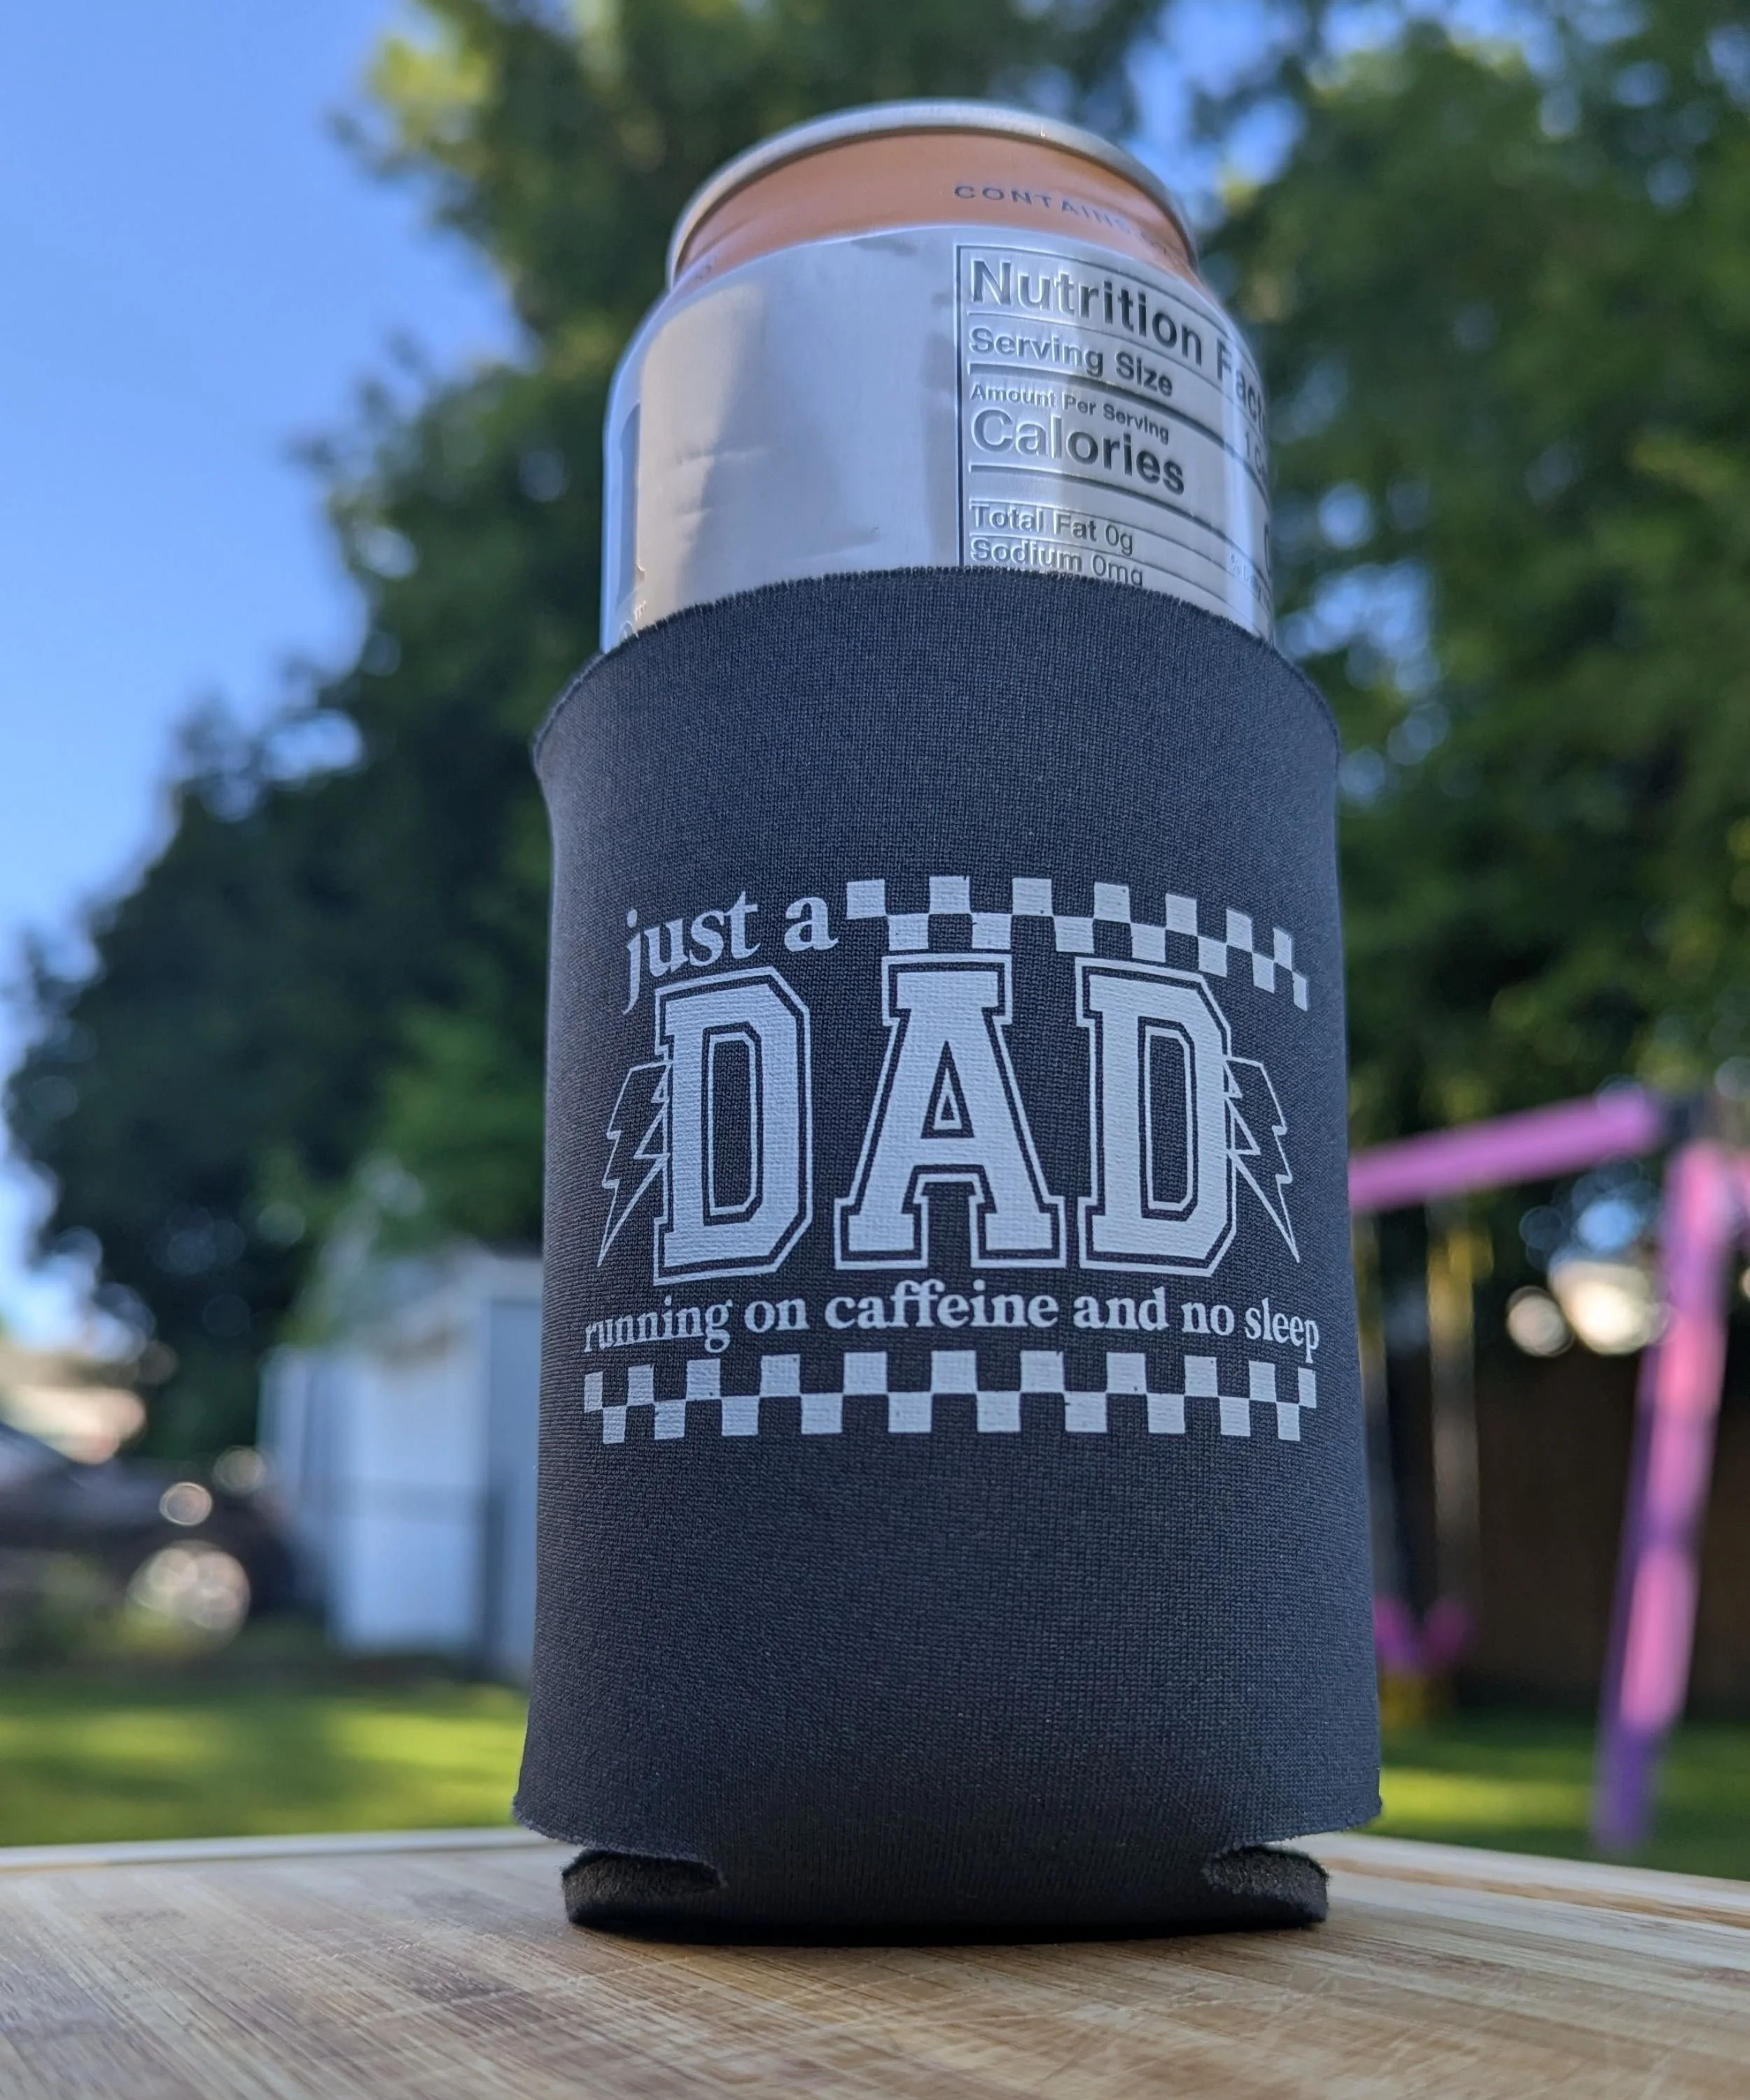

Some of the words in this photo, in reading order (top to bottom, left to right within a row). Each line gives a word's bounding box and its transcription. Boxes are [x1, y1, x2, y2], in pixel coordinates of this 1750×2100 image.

[970, 257, 1203, 366] Nutrition
[969, 326, 1104, 377] Serving
[1115, 351, 1173, 397] Size
[969, 382, 1057, 407] Amount
[1062, 391, 1097, 416] Per
[1102, 402, 1170, 446] Serving
[970, 407, 1184, 496] Calories
[970, 537, 1083, 573] Sodium
[1091, 554, 1143, 587] 0mg
[971, 503, 1044, 533] Total
[1053, 510, 1097, 542] Fat
[1105, 524, 1133, 556] 0g
[623, 890, 762, 1015] just
[783, 896, 839, 953] a
[653, 951, 1236, 1285] DAD
[584, 1294, 734, 1354] running
[743, 1296, 808, 1333] on
[824, 1278, 1060, 1330] caffeine
[1072, 1286, 1169, 1331] and
[1180, 1301, 1236, 1336] no
[1244, 1297, 1320, 1364] sleep
